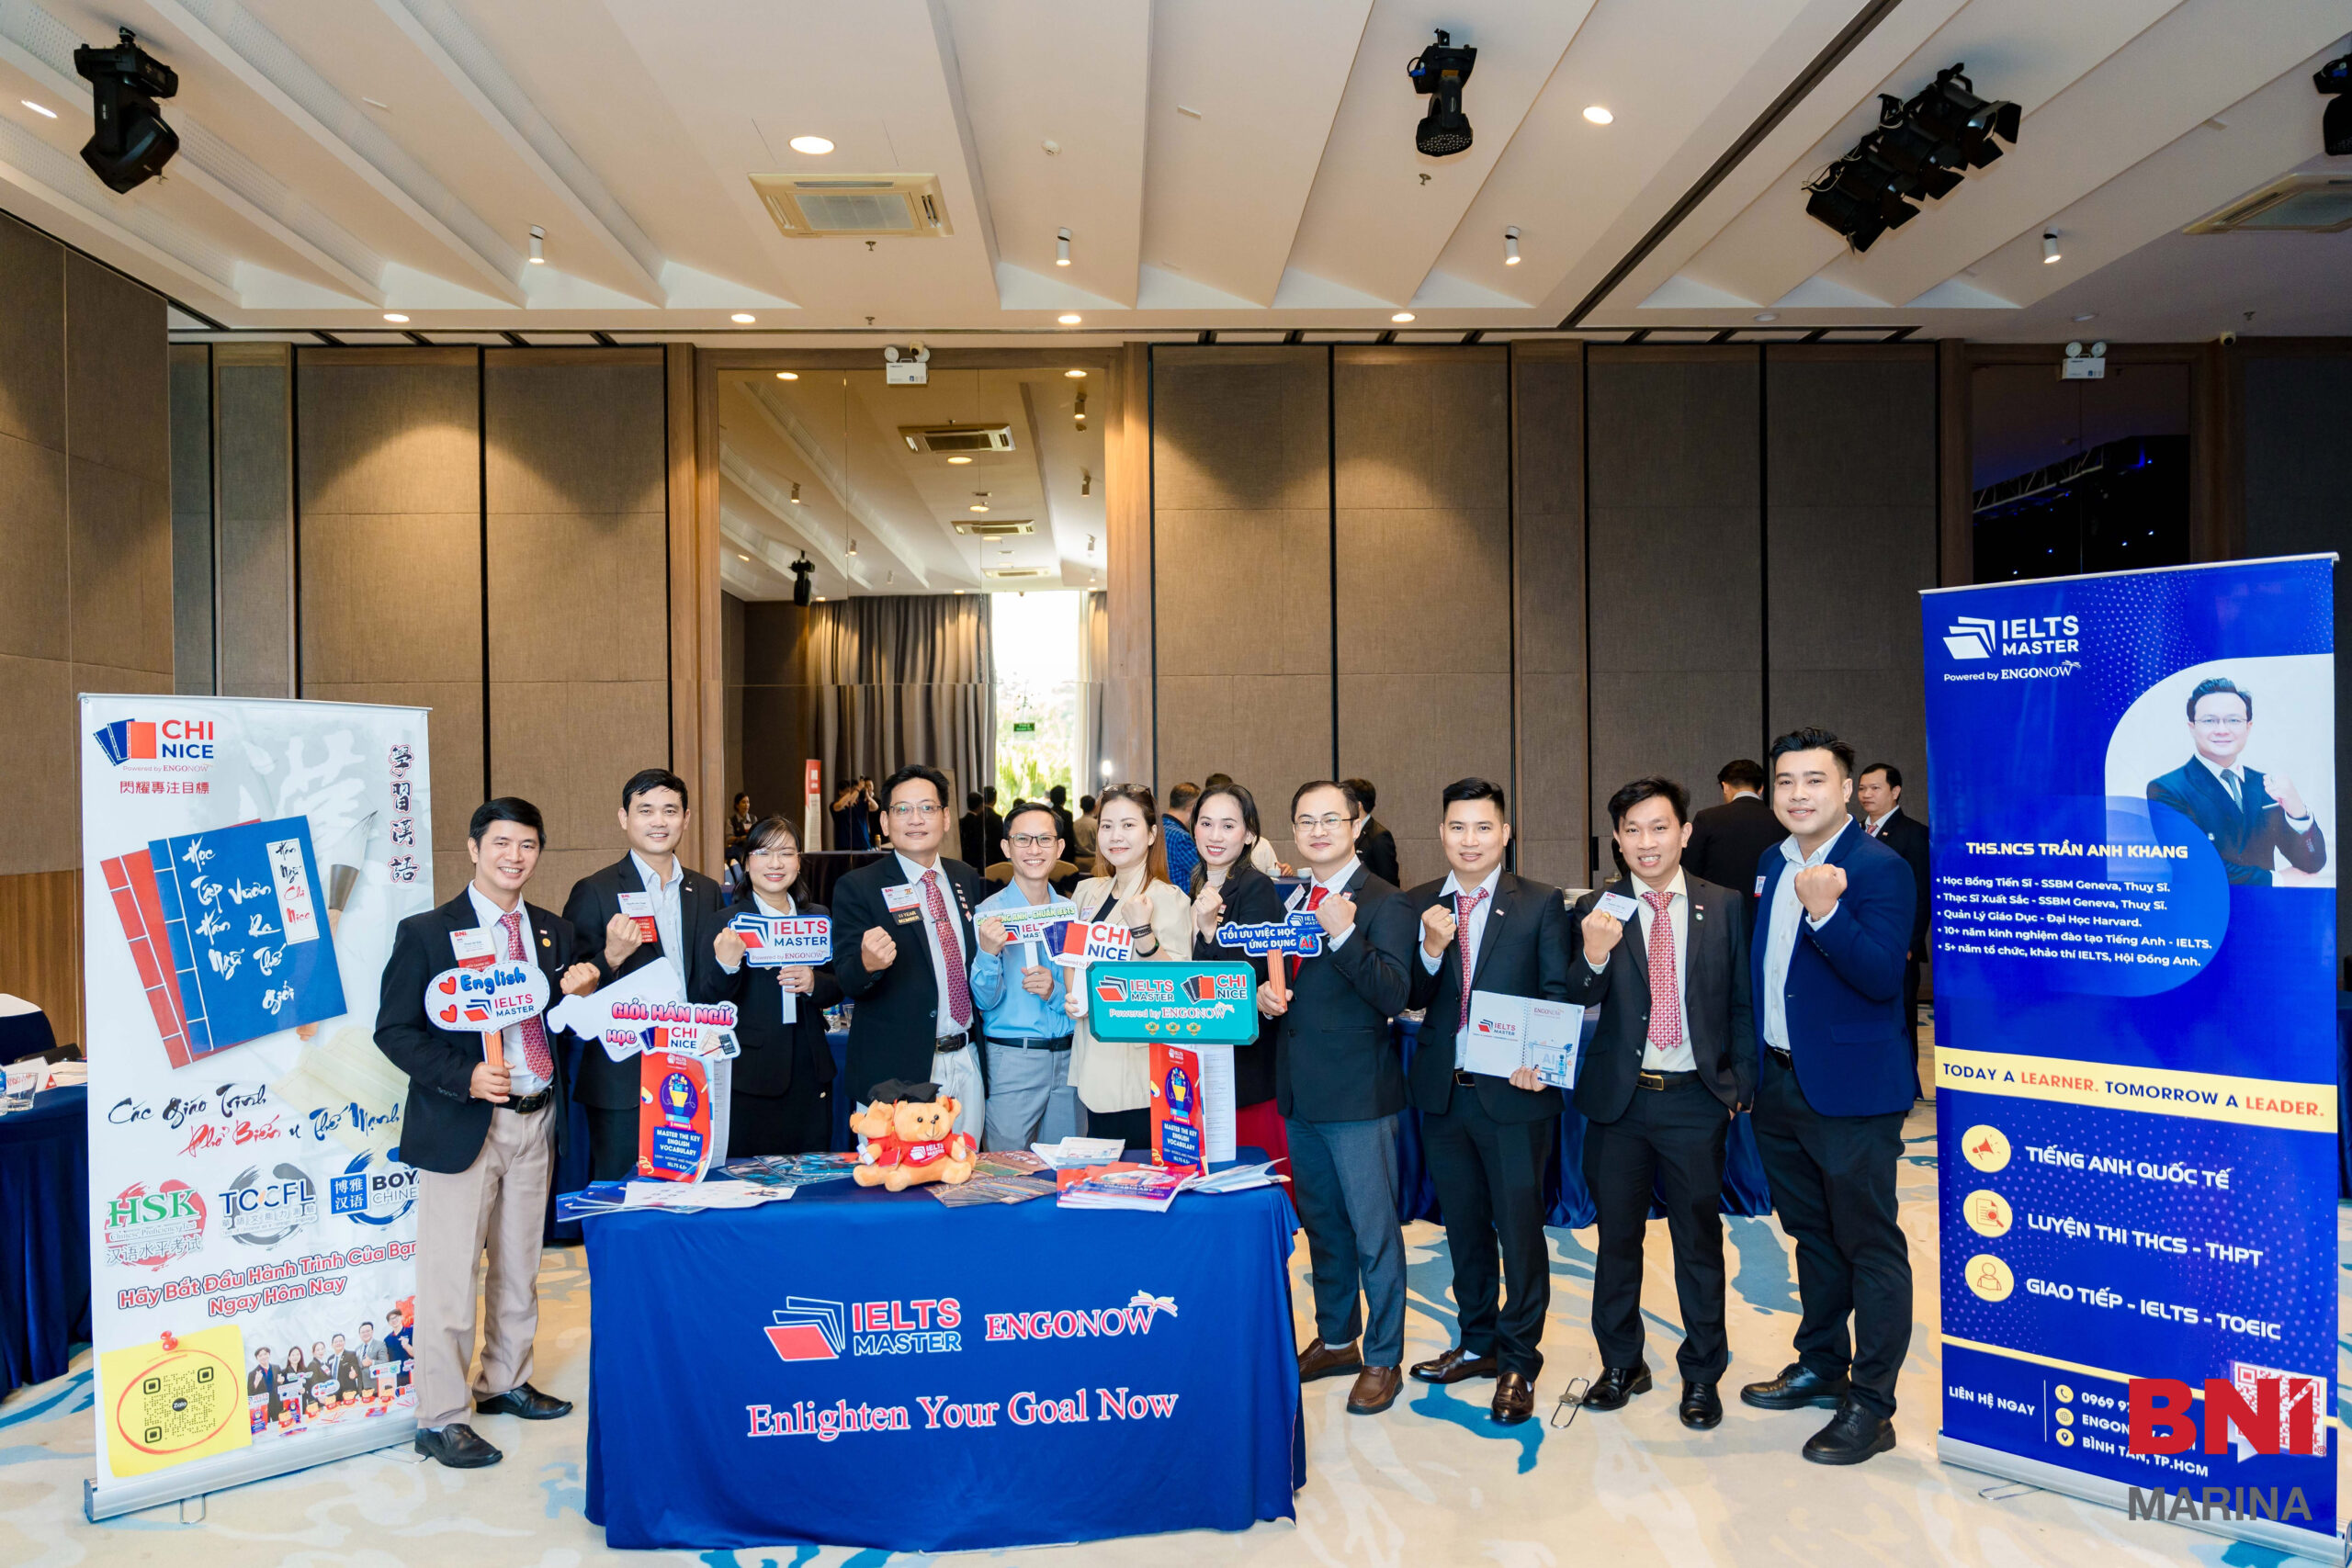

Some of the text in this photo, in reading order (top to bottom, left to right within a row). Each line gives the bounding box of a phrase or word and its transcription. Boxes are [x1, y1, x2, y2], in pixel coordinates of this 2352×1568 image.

[2002, 615, 2079, 639] IELTS
[2003, 639, 2078, 656] MASTER
[1944, 665, 2072, 682] Powered by ENGONOW
[162, 719, 213, 740] CHI
[162, 743, 214, 759] NICE
[153, 765, 162, 773] by
[163, 764, 209, 773] ENGONOW
[182, 836, 216, 873] Học
[1966, 840, 2188, 859] THS.NCS TRẦN ANH KHANG
[1943, 876, 1962, 886] Học
[1996, 877, 2019, 887] Tiến
[2021, 878, 2032, 887] Sĩ
[2041, 879, 2074, 888] SSBM
[2075, 881, 2121, 892] Geneva,
[1943, 893, 1968, 903] Thạc
[1970, 894, 1979, 903] Sĩ
[1982, 894, 2007, 904] Xuất
[2009, 894, 2030, 904] Sắc
[2039, 897, 2071, 906] SSBM
[2073, 898, 2119, 909] Geneva,
[1012, 912, 1028, 921] ANH
[1944, 909, 2142, 927] Quản Lý Giáo Dục Đại Học Harvard.
[775, 920, 827, 935] IELTS
[1091, 924, 1131, 946] CHI
[1222, 928, 1238, 940] TỐI
[1254, 927, 1275, 939] VIỆC
[1277, 928, 1296, 938] HỌC
[775, 937, 827, 946] MASTER
[1250, 938, 1296, 950] ỨNG DỤNG
[1944, 926, 2212, 949] 10+ năm kinh nghiệm đào tạo Tiếng Anh IELTS.
[1088, 943, 1128, 961] NICE
[1944, 942, 1956, 952] 5+
[1958, 944, 1982, 953] năm
[1997, 946, 2028, 957] chức,
[2030, 947, 2058, 958] khảo
[2060, 949, 2075, 959] thí
[2078, 951, 2111, 963] IELTS,
[2114, 953, 2133, 964] Hội
[2173, 956, 2200, 966] Anh.
[460, 966, 526, 995] English
[1130, 980, 1174, 992] IELTS
[1216, 975, 1247, 987] CHI
[494, 993, 533, 1009] IELTS
[1131, 993, 1174, 1001] MASTER
[1217, 989, 1248, 999] NICE
[496, 1005, 535, 1017] MASTER
[612, 998, 734, 1026] GIỎI HÁN NGỮ
[1110, 1007, 1226, 1020] Powered by ENGONOW
[671, 1027, 697, 1038] CHI
[1494, 1022, 1516, 1032] IELTS
[606, 1029, 637, 1046] HỌC
[671, 1039, 696, 1049] NICE
[1943, 1063, 2324, 1117] TODAY A LEARNER. TOMORROW A LEADER.
[108, 1097, 154, 1123] Các
[657, 1129, 678, 1138] MASTER
[660, 1145, 696, 1156] VOCABULARY
[667, 1138, 690, 1147] ENGLISH
[2025, 1145, 2233, 1190] TIẾNG ANH QUỐC TẾ
[372, 1169, 420, 1191] BOY
[372, 1188, 419, 1204] CHINE
[107, 1190, 198, 1227] HSK
[2028, 1213, 2264, 1268] LUYỆN THI THCS THPT
[106, 1235, 201, 1264] 汉语水平考试
[119, 1246, 385, 1308] Hãy Bắt Đầu Hành Trình Của
[209, 1277, 346, 1317] Ngay Hôm Nay
[853, 1298, 962, 1332] IELTS
[2027, 1278, 2281, 1340] GIAO TIẾP IELTS TOEIC
[985, 1306, 1157, 1341] ENGONOW
[854, 1331, 962, 1356] MASTER
[1949, 1386, 2035, 1416] LIÊN HỆ NGAY
[2081, 1392, 2115, 1409] 0969
[747, 1387, 1179, 1441] Enlighten Your Goal Now
[2082, 1437, 2209, 1477] BÌNH TP.HCM
